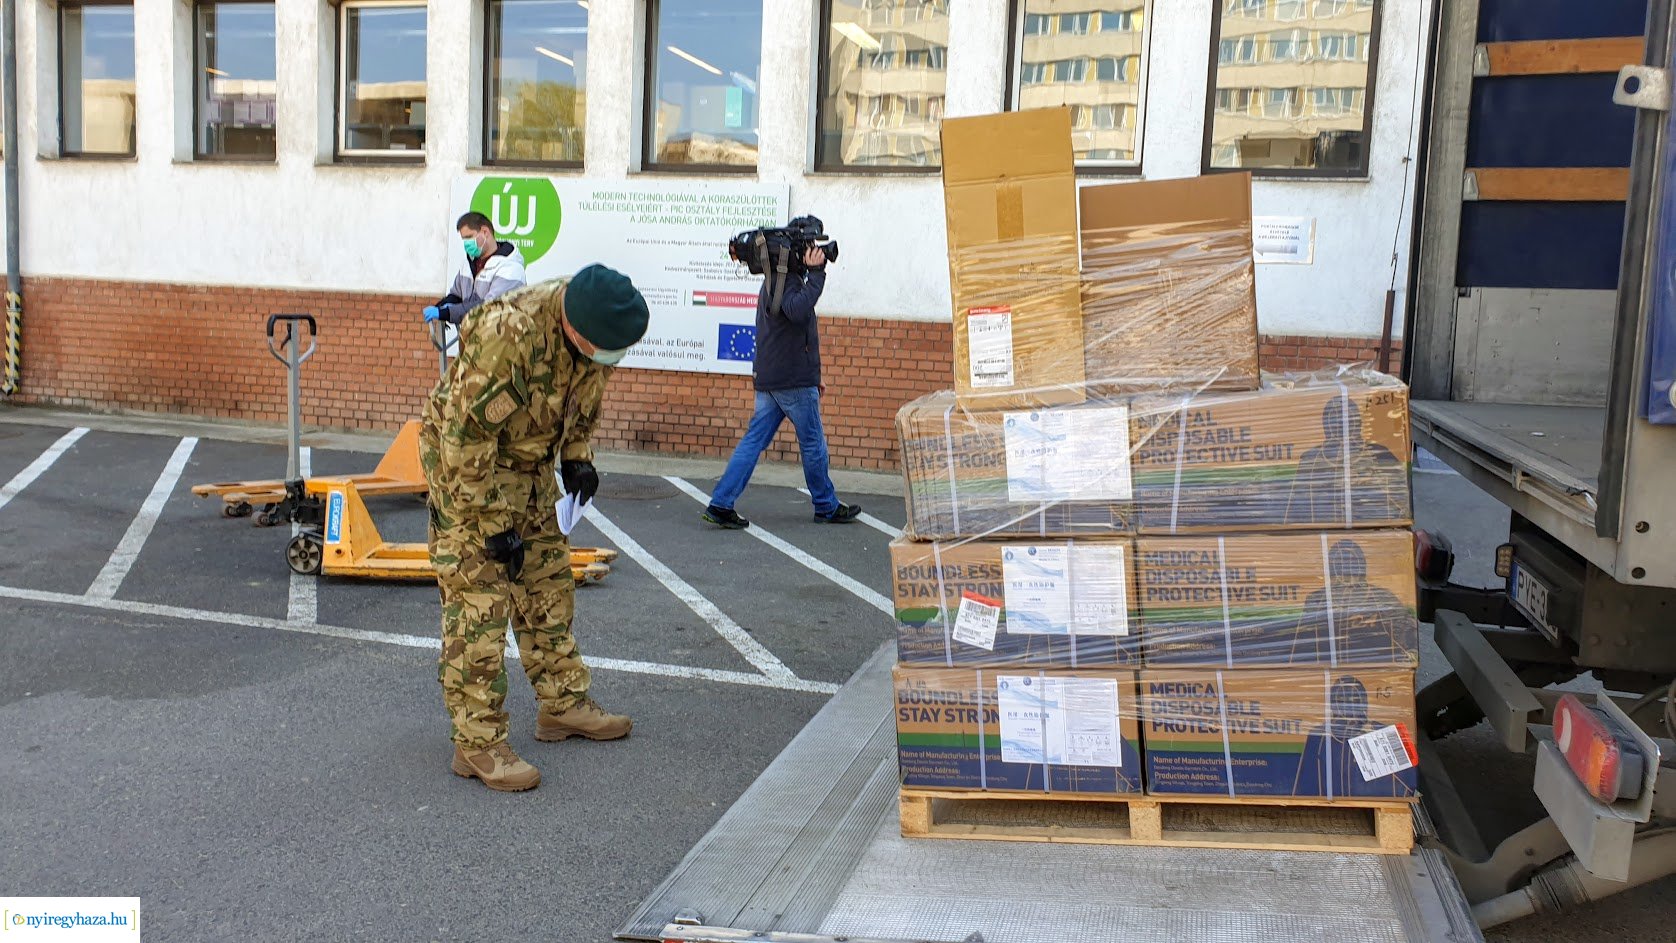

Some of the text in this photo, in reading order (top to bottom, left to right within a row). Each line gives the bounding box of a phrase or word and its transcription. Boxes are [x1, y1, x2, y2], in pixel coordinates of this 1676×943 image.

[592, 191, 778, 206] MODERN TECHNOLÓGIÁVAL A KORASZÜLÖTTEK
[492, 182, 536, 235] ÚJ
[671, 205, 683, 214] PIC
[685, 204, 721, 215] OSZTÁLY
[722, 205, 777, 217] FEJLESZTÉSE
[630, 215, 636, 223] A
[638, 213, 657, 224] JÓSA
[659, 214, 693, 226] ANDRÁS
[676, 338, 705, 348] Európai
[658, 350, 685, 359] valósul
[686, 353, 706, 361] meg.
[1139, 410, 1217, 428] MICAL
[1141, 427, 1252, 447] ISPOSABLE
[1254, 444, 1295, 461] SUIT
[1144, 550, 1222, 567] MEDICAL
[897, 563, 1003, 580] BOUNDLESS
[1145, 567, 1257, 585] DISPOSABLE
[898, 582, 940, 598] STAY
[944, 582, 1004, 598] STRON
[1259, 585, 1300, 601] SUIT
[1150, 682, 1228, 698] MEDICA
[899, 707, 941, 722] STAY
[1151, 700, 1261, 716] DISPOSABLE
[1153, 718, 1303, 735] PROTECIVE SUIT
[900, 750, 918, 758] Name
[969, 752, 1001, 761] Entprise
[1153, 756, 1173, 764] Name
[1173, 756, 1181, 764] of
[1182, 757, 1227, 765] Manufacturin
[1154, 771, 1220, 781] Production Address:
